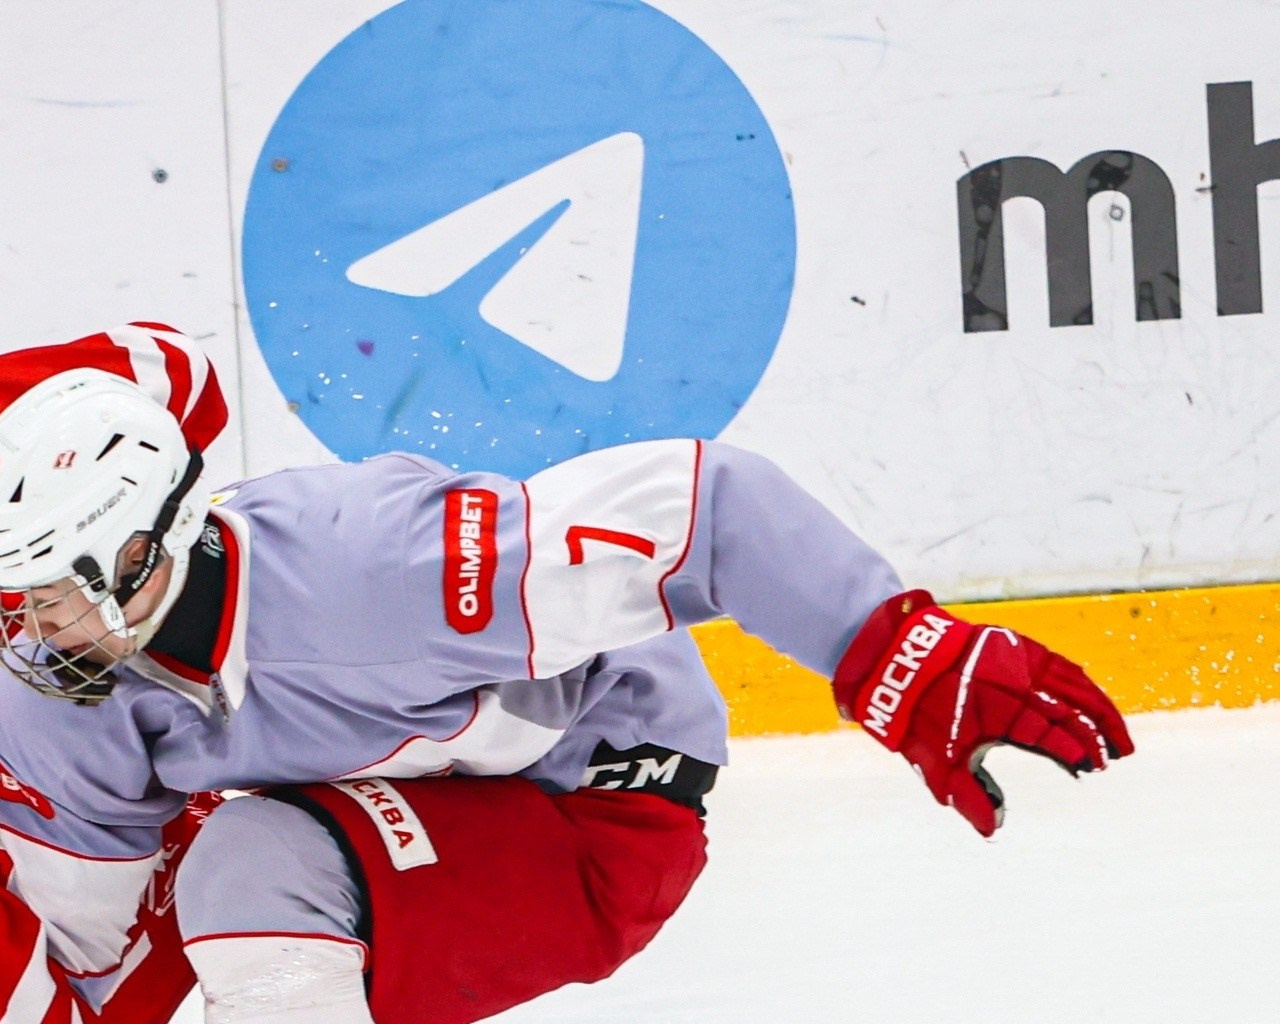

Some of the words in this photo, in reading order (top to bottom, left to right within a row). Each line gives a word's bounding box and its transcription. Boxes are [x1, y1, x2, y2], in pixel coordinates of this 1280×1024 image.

[458, 492, 483, 617] OLIMPBET
[565, 525, 656, 566] 7
[863, 613, 954, 738] МОСКВА
